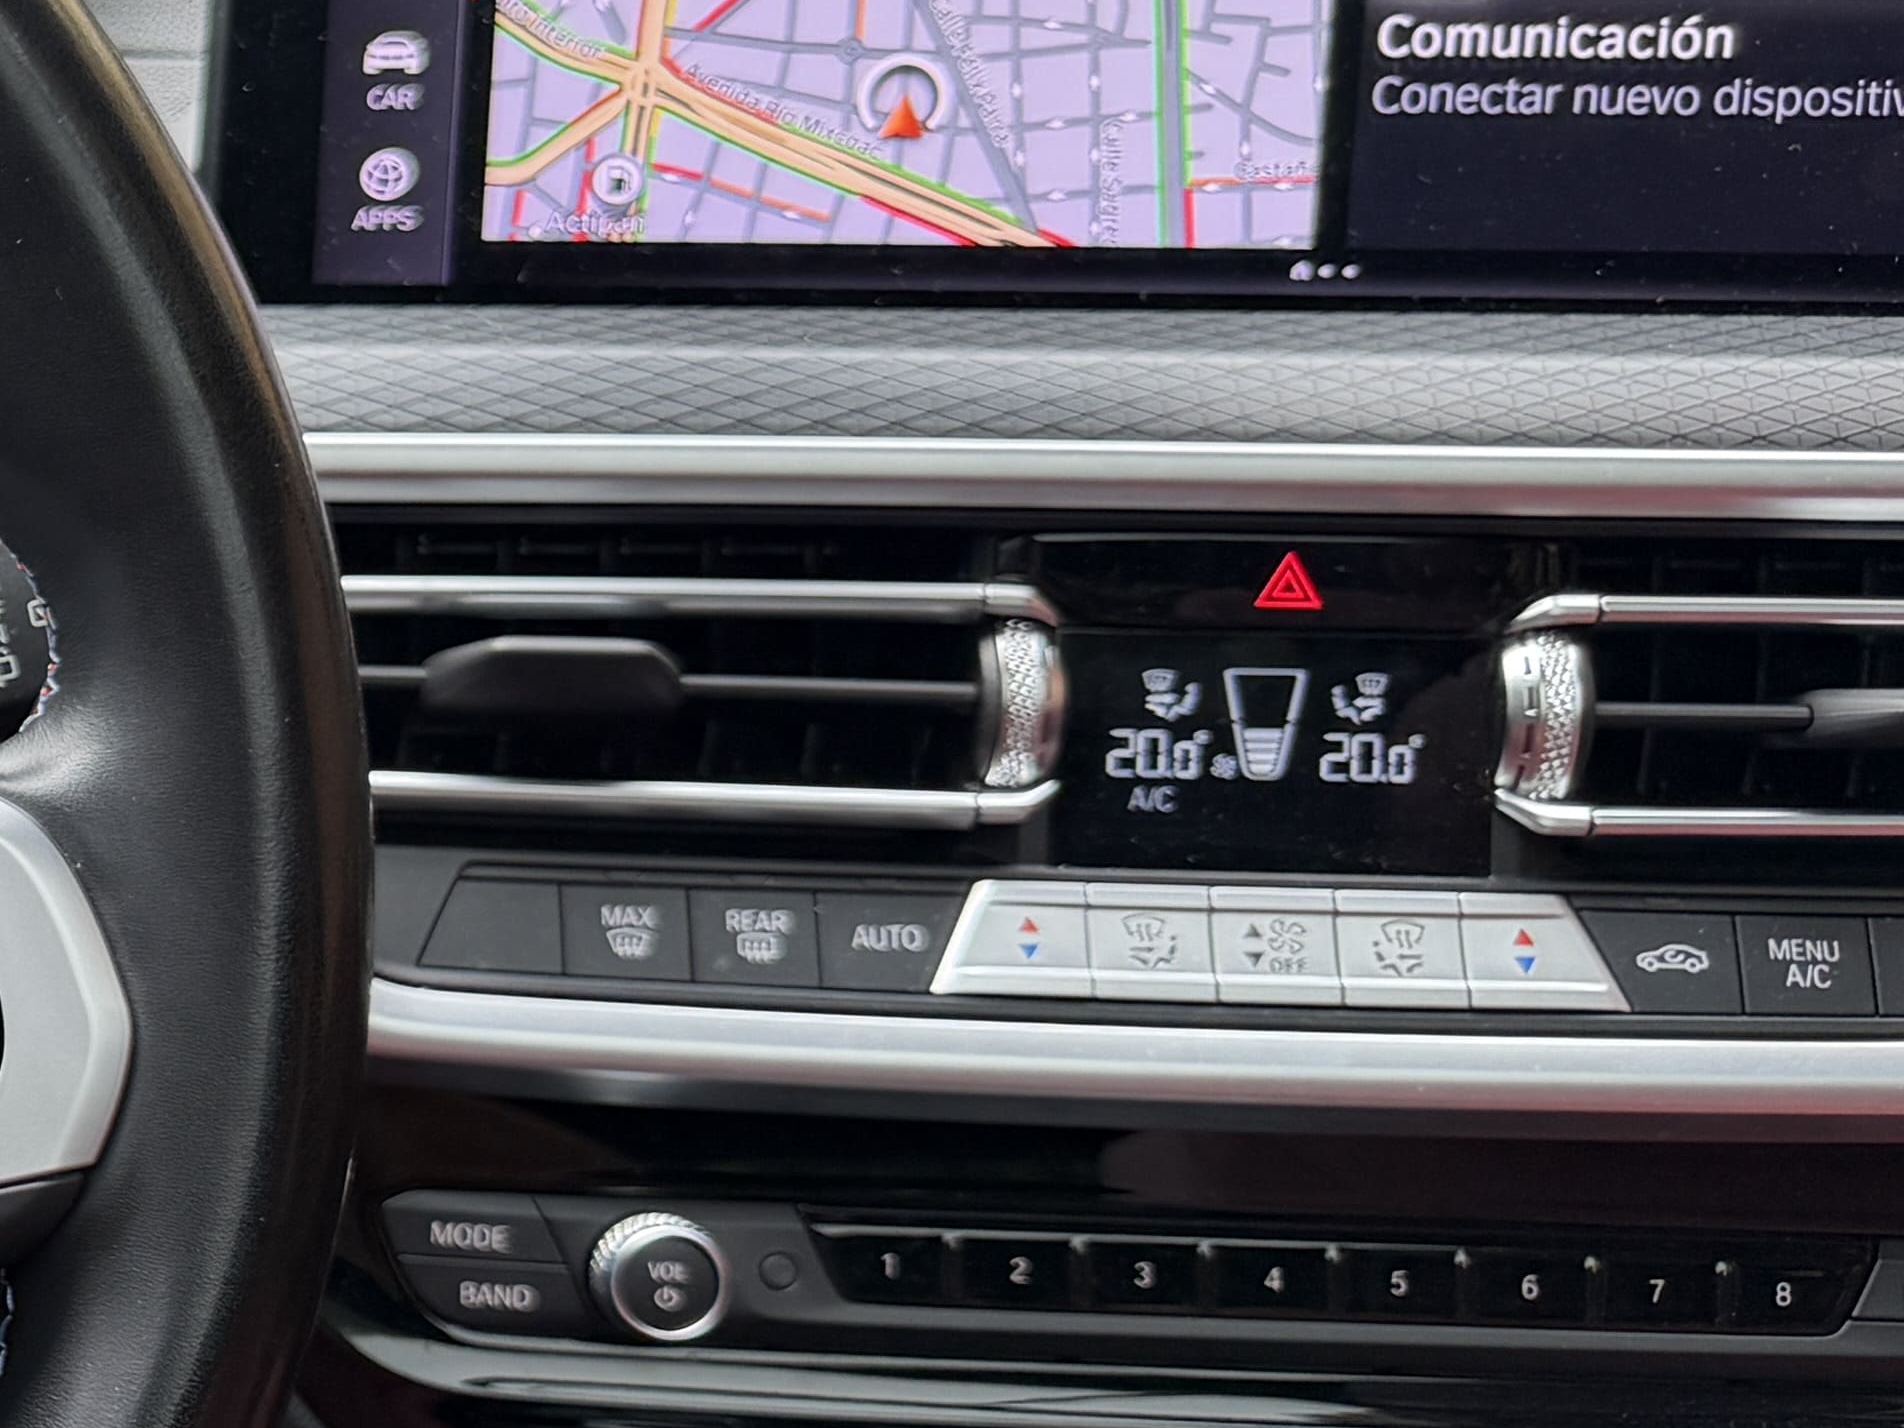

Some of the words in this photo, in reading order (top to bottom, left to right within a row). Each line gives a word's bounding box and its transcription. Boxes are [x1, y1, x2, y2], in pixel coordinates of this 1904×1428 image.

[1376, 13, 1735, 60] Comunicación
[366, 83, 425, 111] CAR
[686, 63, 759, 111] Avenida
[1371, 74, 1564, 117] Conectar
[1572, 83, 1702, 117] nuevo
[351, 205, 425, 232] APPS
[1126, 784, 1181, 814] A/C
[600, 903, 658, 929] MAX
[724, 907, 797, 934] REAR
[851, 923, 931, 953] AUTO
[1767, 937, 1841, 963] MENU
[1785, 963, 1833, 989] A/C
[429, 1220, 513, 1254] MODE
[647, 1259, 690, 1285] VOL
[880, 1252, 901, 1280] 1
[1009, 1256, 1033, 1285] 2
[1133, 1261, 1159, 1290] 3
[1263, 1266, 1286, 1293] 4
[1390, 1270, 1409, 1298] 5
[1520, 1274, 1539, 1301] 6
[1649, 1279, 1666, 1305] 7
[1775, 1281, 1792, 1307] 8
[458, 1280, 542, 1313] BAND
